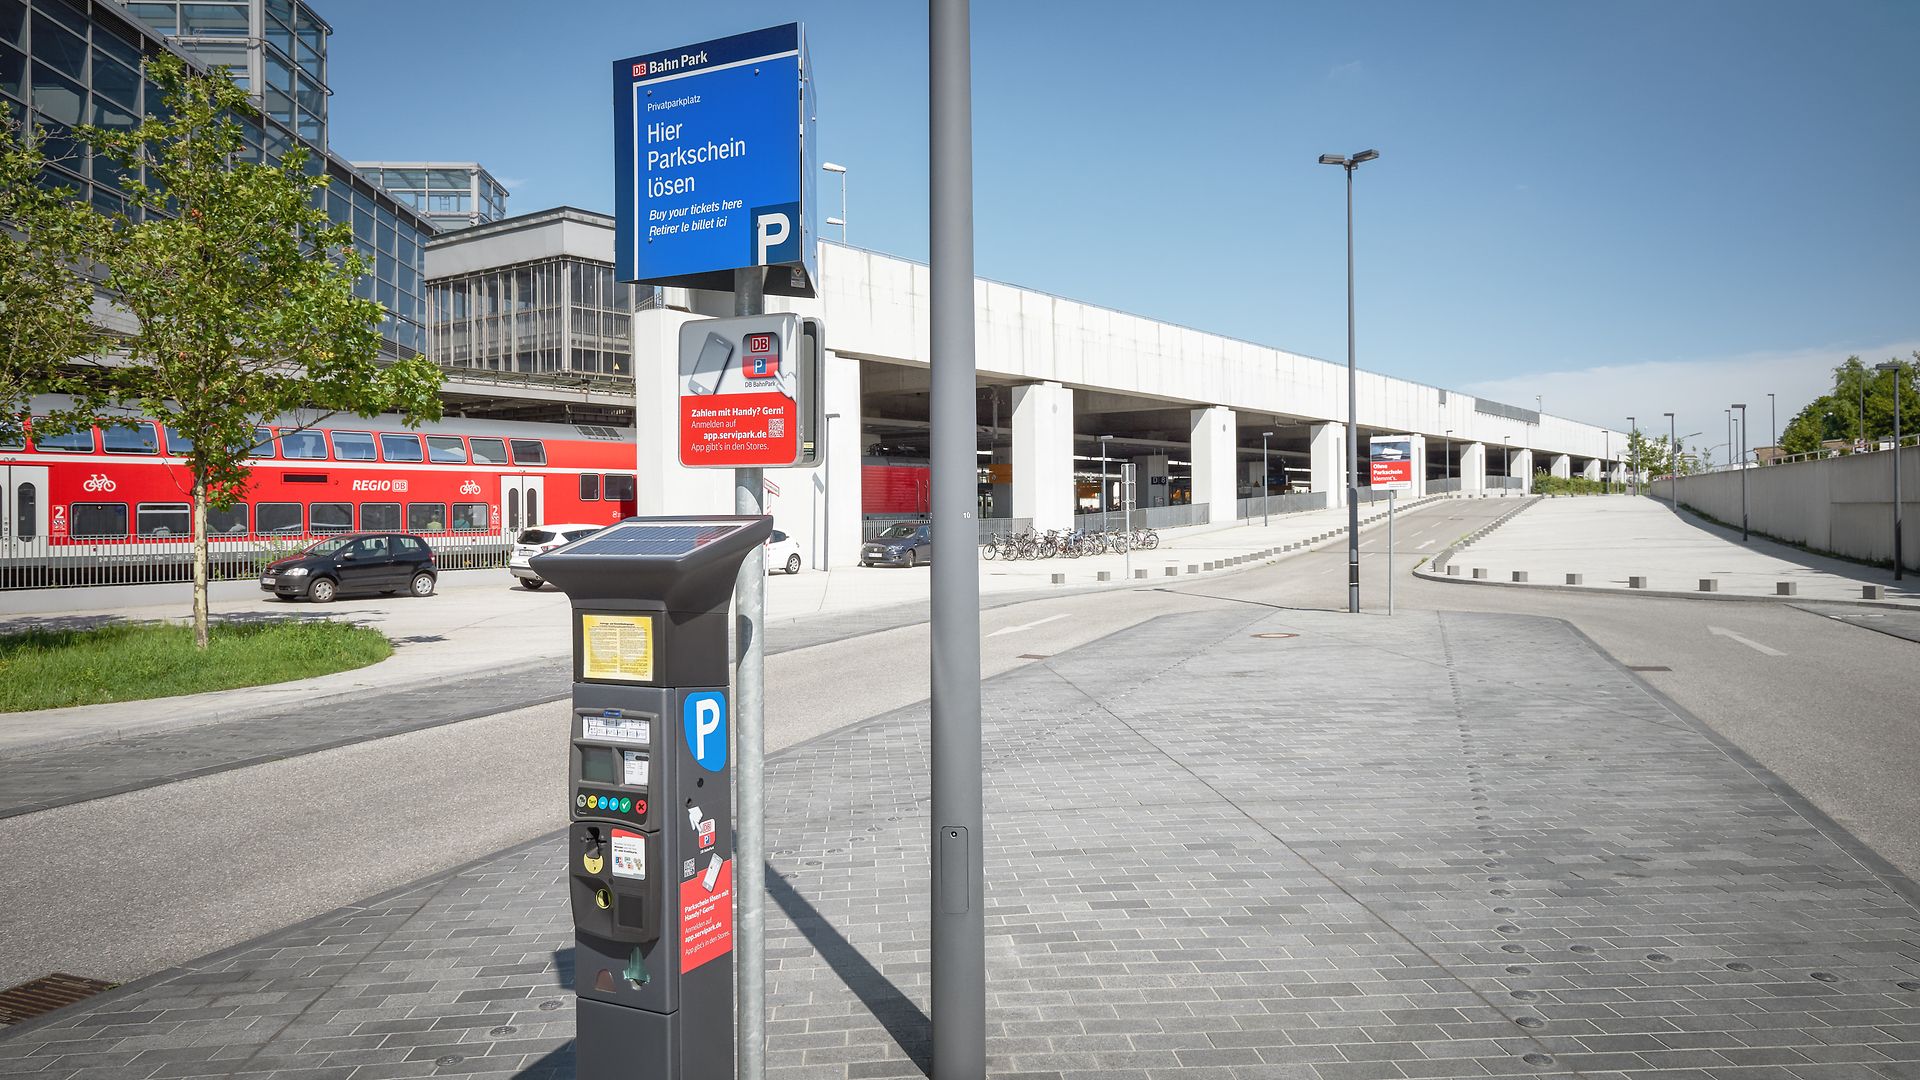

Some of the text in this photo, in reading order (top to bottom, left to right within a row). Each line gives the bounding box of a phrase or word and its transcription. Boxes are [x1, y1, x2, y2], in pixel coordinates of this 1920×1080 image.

[634, 50, 708, 76] DB Bahn Park
[647, 94, 701, 112] Privatparkplatz
[647, 121, 683, 144] Hier
[648, 137, 746, 171] Parkschein
[648, 176, 696, 198] lösen
[649, 199, 743, 221] Buy your tickets here
[649, 216, 728, 238] Retirer le billet ici
[757, 212, 790, 265] P
[752, 338, 768, 351] DB
[754, 360, 762, 373] P
[692, 406, 784, 418] Zahlen mit Handy? Gern!
[691, 419, 736, 428] Anmelden auf
[704, 430, 767, 441] app.servipark.de
[691, 444, 704, 452] App
[724, 442, 731, 450] in
[732, 442, 745, 450] den
[746, 442, 769, 450] Stores.
[352, 480, 406, 491] REGIO DB
[54, 506, 64, 519] 2
[492, 505, 498, 516] 2
[696, 698, 720, 761] P
[684, 898, 710, 913] Parkschein
[684, 909, 702, 922] Handy?
[685, 922, 722, 942] app.servipark.de
